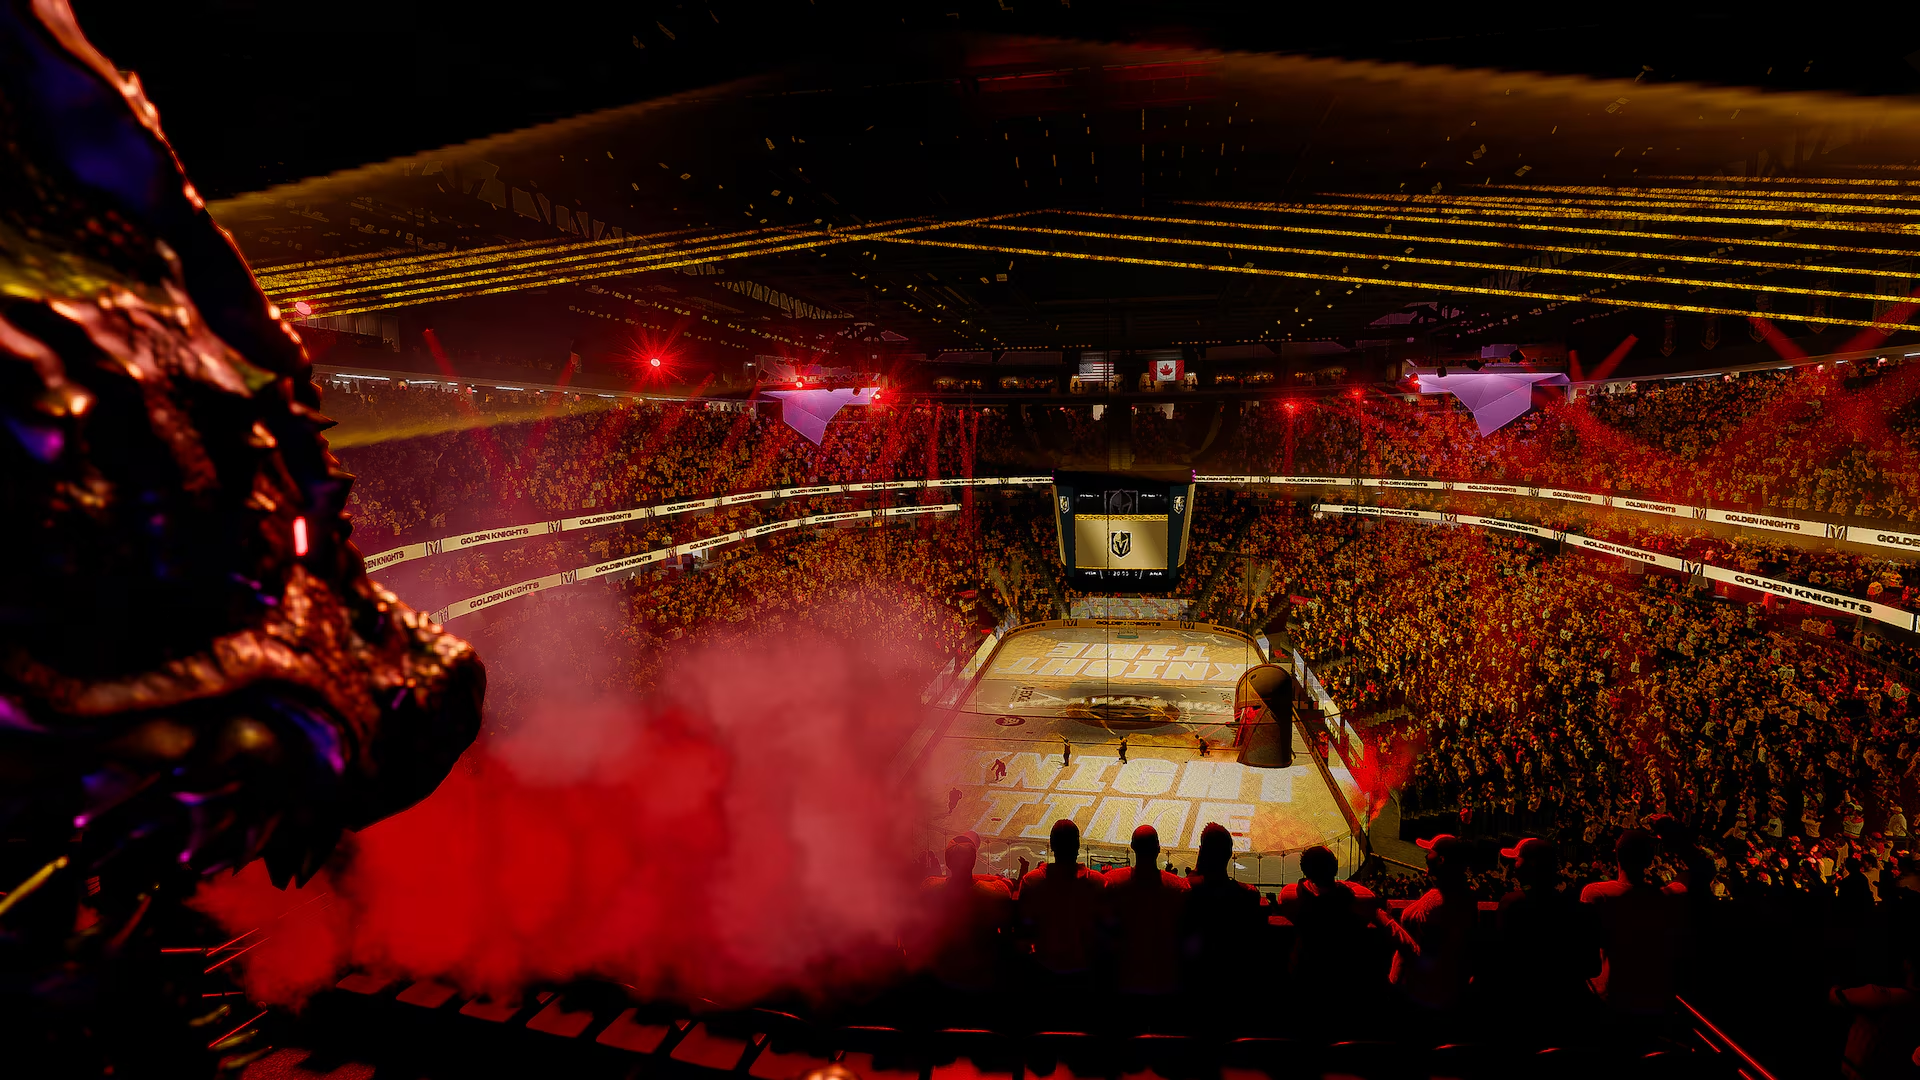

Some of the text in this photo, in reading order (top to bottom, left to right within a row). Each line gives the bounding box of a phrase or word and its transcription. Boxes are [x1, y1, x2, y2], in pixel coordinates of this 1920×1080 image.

[1625, 500, 1676, 513] GOLDEN KNIGHTS
[579, 512, 632, 526] GOLDEN KNIGHTS
[1480, 518, 1539, 534] GOLDEN KNIGHTS
[1725, 514, 1800, 531] GOLDEN KNIGHTS
[460, 527, 529, 546] GOLDEN KNIGHTS
[1877, 533, 1920, 547] GOLDE
[1583, 540, 1656, 562] GOLDEN KNIGHTS
[595, 554, 652, 574] GOLDEN KNIGHTS
[469, 581, 540, 609] GOLDEN KNIGHTS
[1734, 575, 1873, 614] GOLDEN KNIGHTS
[970, 790, 1256, 853] TIME
